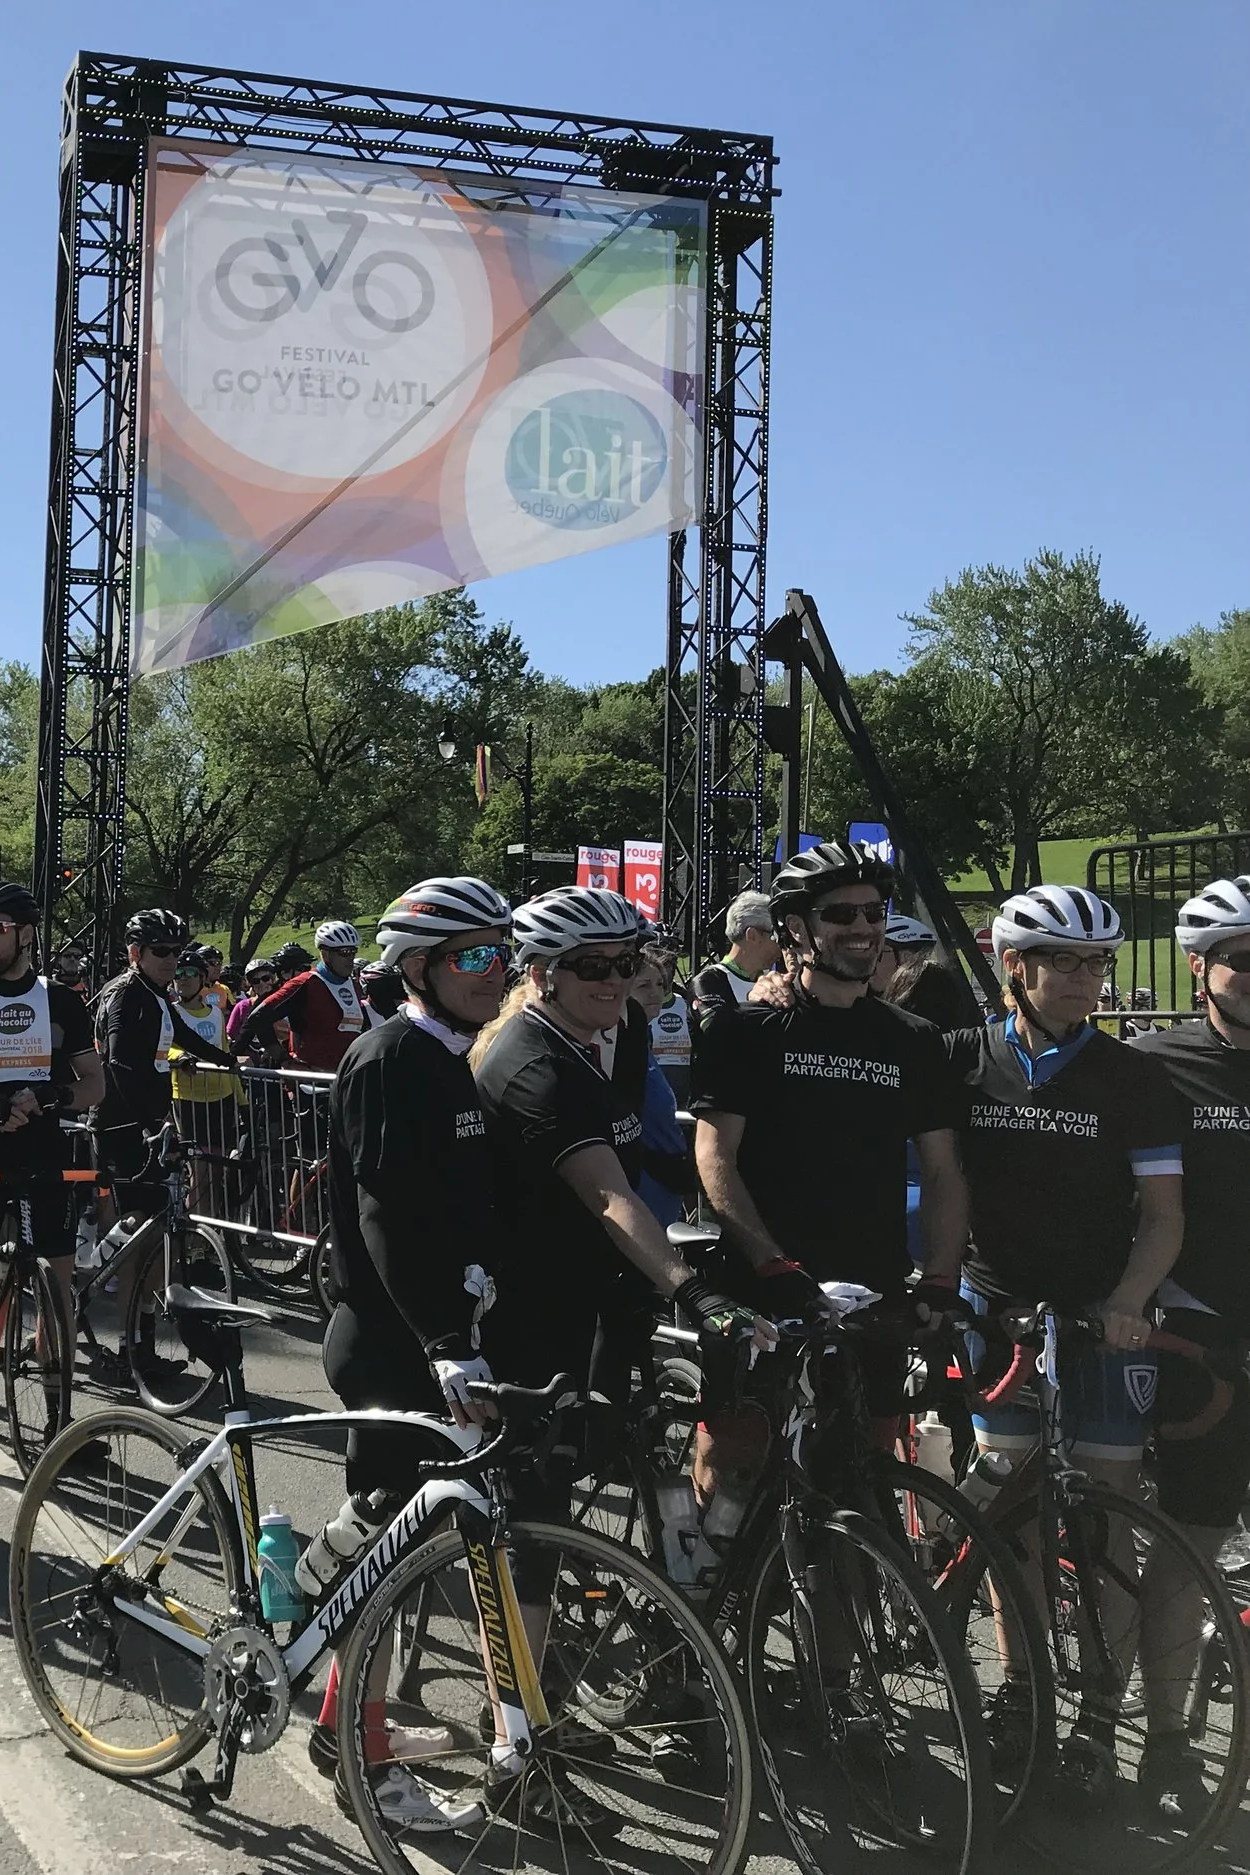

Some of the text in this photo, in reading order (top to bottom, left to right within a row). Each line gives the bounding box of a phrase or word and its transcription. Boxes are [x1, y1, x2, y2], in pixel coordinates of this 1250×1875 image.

[280, 346, 370, 366] FESTIVAL
[212, 368, 262, 394] GO
[531, 406, 659, 509] lait
[580, 850, 618, 864] rouge
[626, 847, 664, 861] rouge
[0, 1009, 17, 1018] lait
[13, 1038, 24, 1046] DE
[22, 1045, 43, 1054] 2018
[784, 1052, 901, 1077] D'UNE VOIX POUR
[783, 1064, 901, 1088] PARTAGER LA VOIE
[971, 1104, 1099, 1126] D'UNE VOIX POUR
[1193, 1106, 1240, 1118] D'UNE
[970, 1117, 1098, 1138] PARTAGER LA VOIE
[317, 1490, 430, 1640] SPECIALIZED
[467, 1537, 515, 1691] SPECIALIZED
